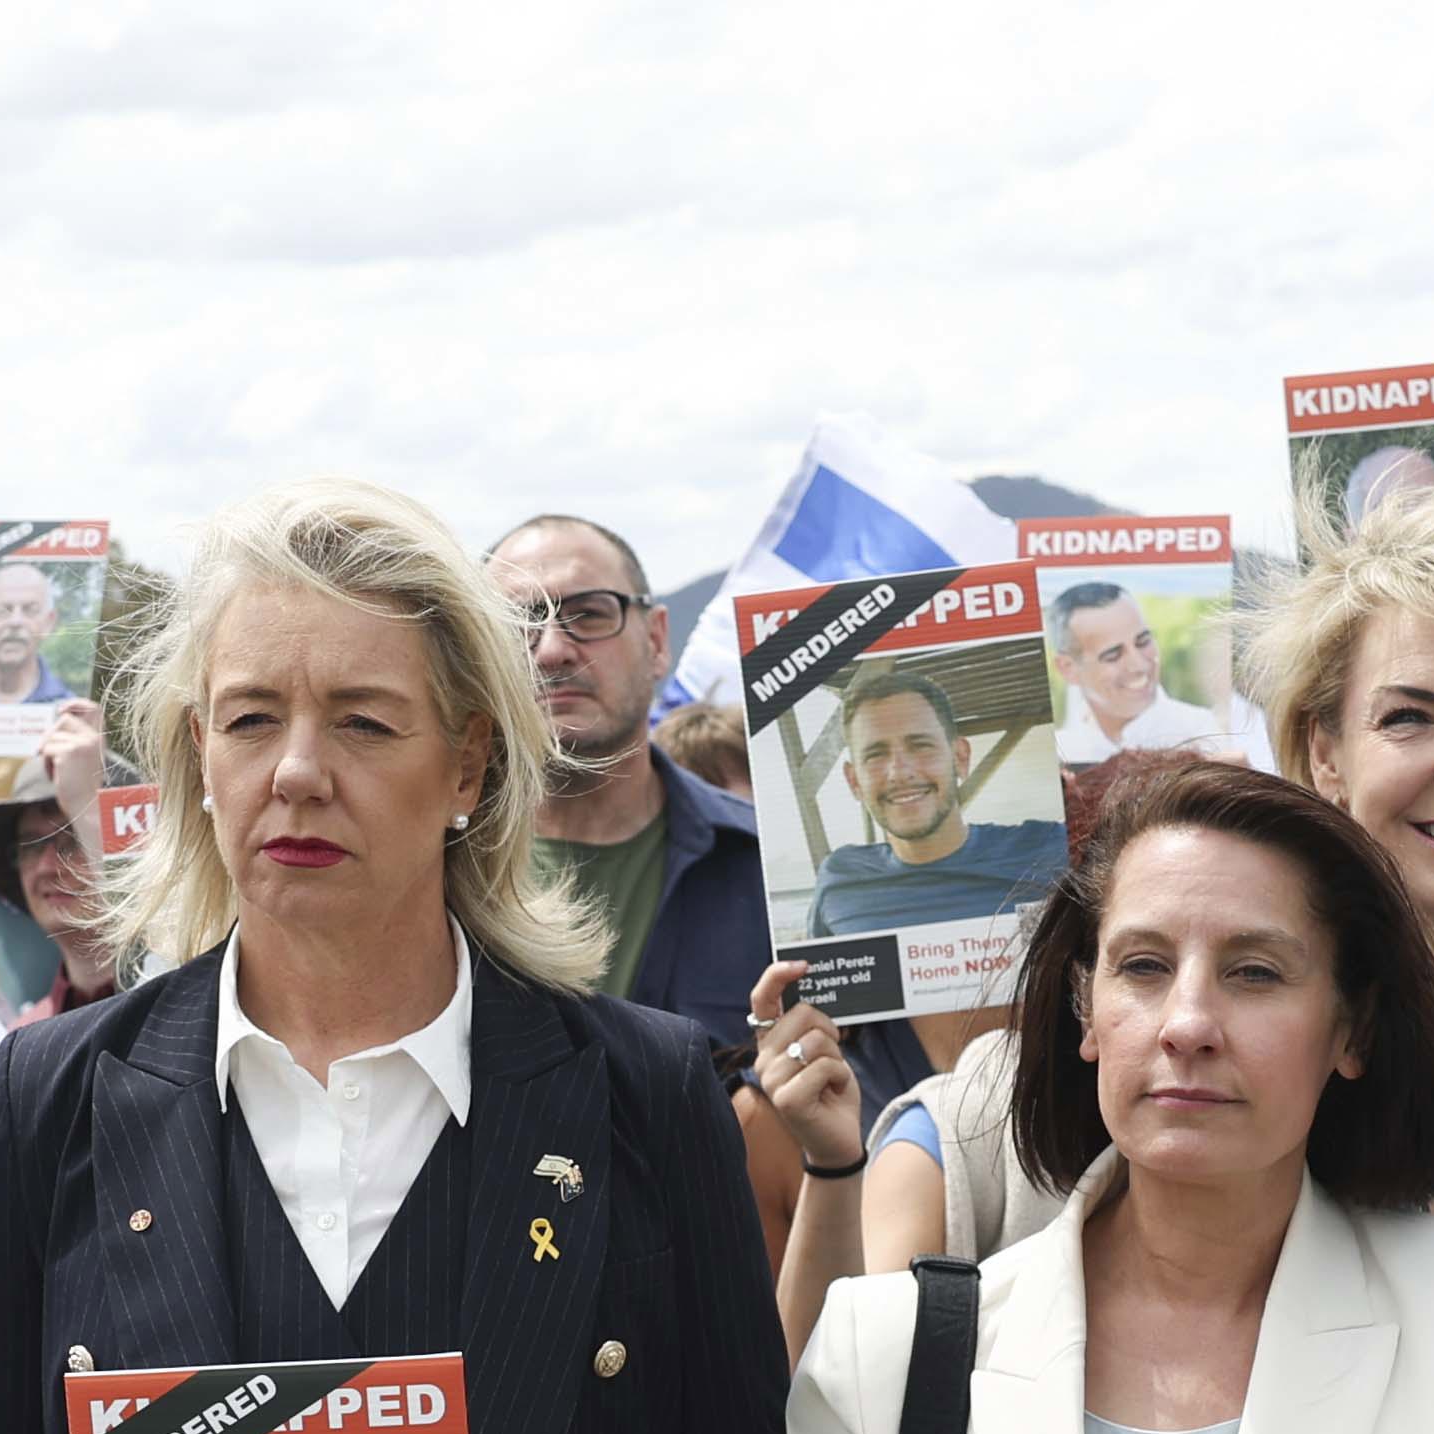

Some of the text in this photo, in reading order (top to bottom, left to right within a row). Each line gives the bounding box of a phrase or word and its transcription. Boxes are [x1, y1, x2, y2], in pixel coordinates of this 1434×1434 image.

[1027, 527, 1222, 556] KIDNAPPED
[752, 582, 1024, 646] KPPED
[750, 583, 896, 702] MURDERED
[907, 936, 1008, 959] Bring Them
[806, 955, 876, 974] aniel Peretz
[909, 965, 960, 981] Home
[798, 970, 871, 991] 22 years old
